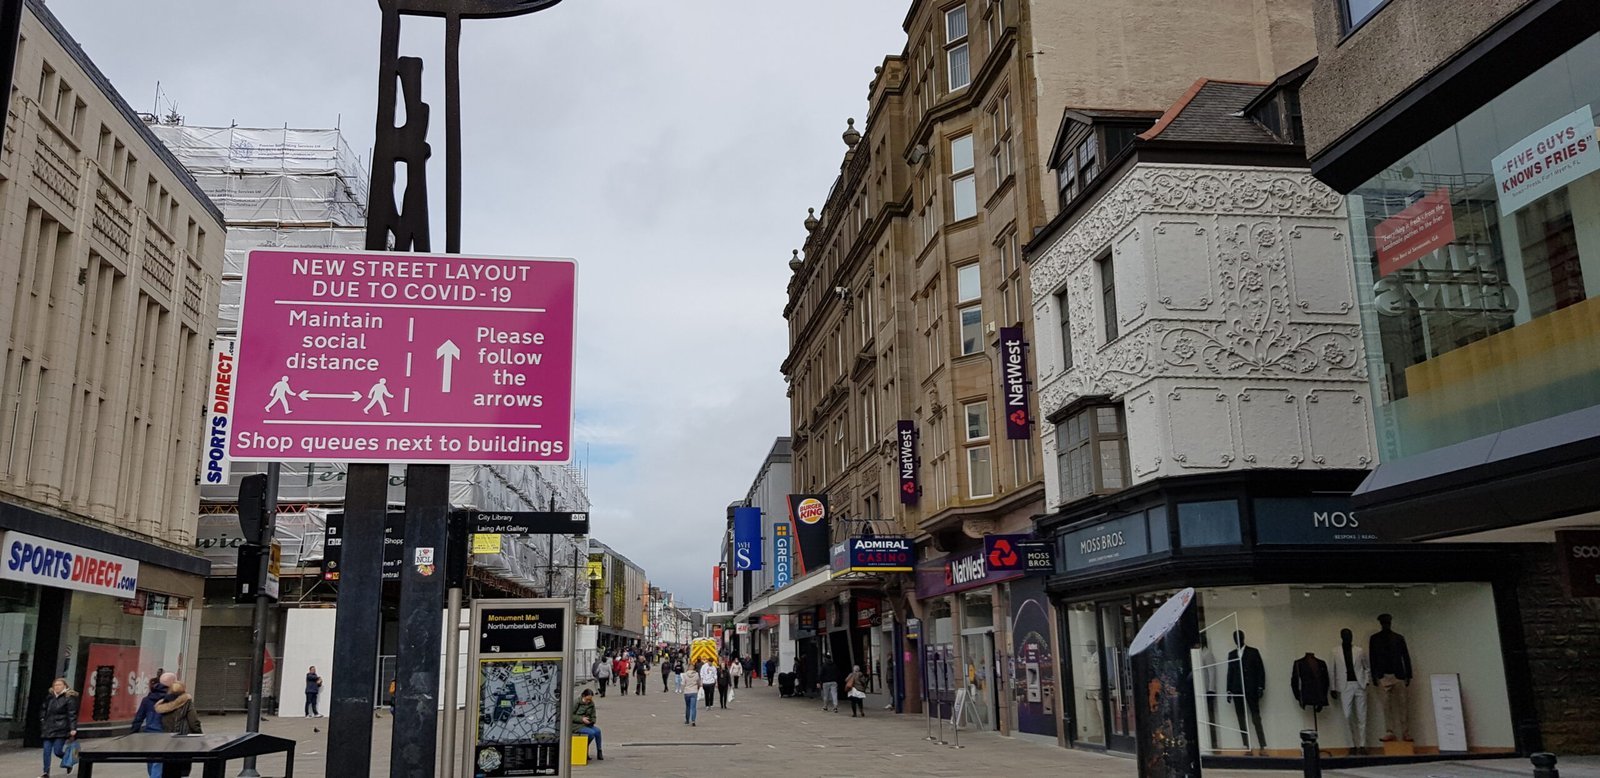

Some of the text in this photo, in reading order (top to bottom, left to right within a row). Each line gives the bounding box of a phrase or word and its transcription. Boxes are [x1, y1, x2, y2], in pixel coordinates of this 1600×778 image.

[1537, 126, 1575, 154] GUYS
[1502, 161, 1542, 194] KNOWS
[292, 258, 531, 282] NEW STREET LAYOUT
[312, 280, 360, 298] DUE
[367, 282, 397, 299] TO
[289, 310, 383, 329] Maintain
[302, 333, 367, 350] social
[477, 327, 545, 345] Please
[286, 352, 380, 371] distance
[478, 347, 543, 365] follow
[493, 369, 527, 386] the
[1005, 340, 1024, 406] NatWest
[473, 393, 544, 408] arrows
[237, 431, 564, 457] Shop queues next to buildings
[901, 429, 914, 479] NatWest
[800, 503, 822, 513] BURGER
[800, 508, 823, 519] KING
[478, 514, 513, 522] City Library
[477, 525, 495, 533] Laing
[506, 525, 529, 533] Gallery
[855, 540, 909, 550] ADMIRAL
[1080, 537, 1101, 554] MOSS
[737, 548, 751, 569] S
[777, 538, 788, 588] GREGGS
[857, 553, 906, 563] CASINO
[1027, 552, 1050, 560] MOSS
[952, 553, 985, 585] NatWest
